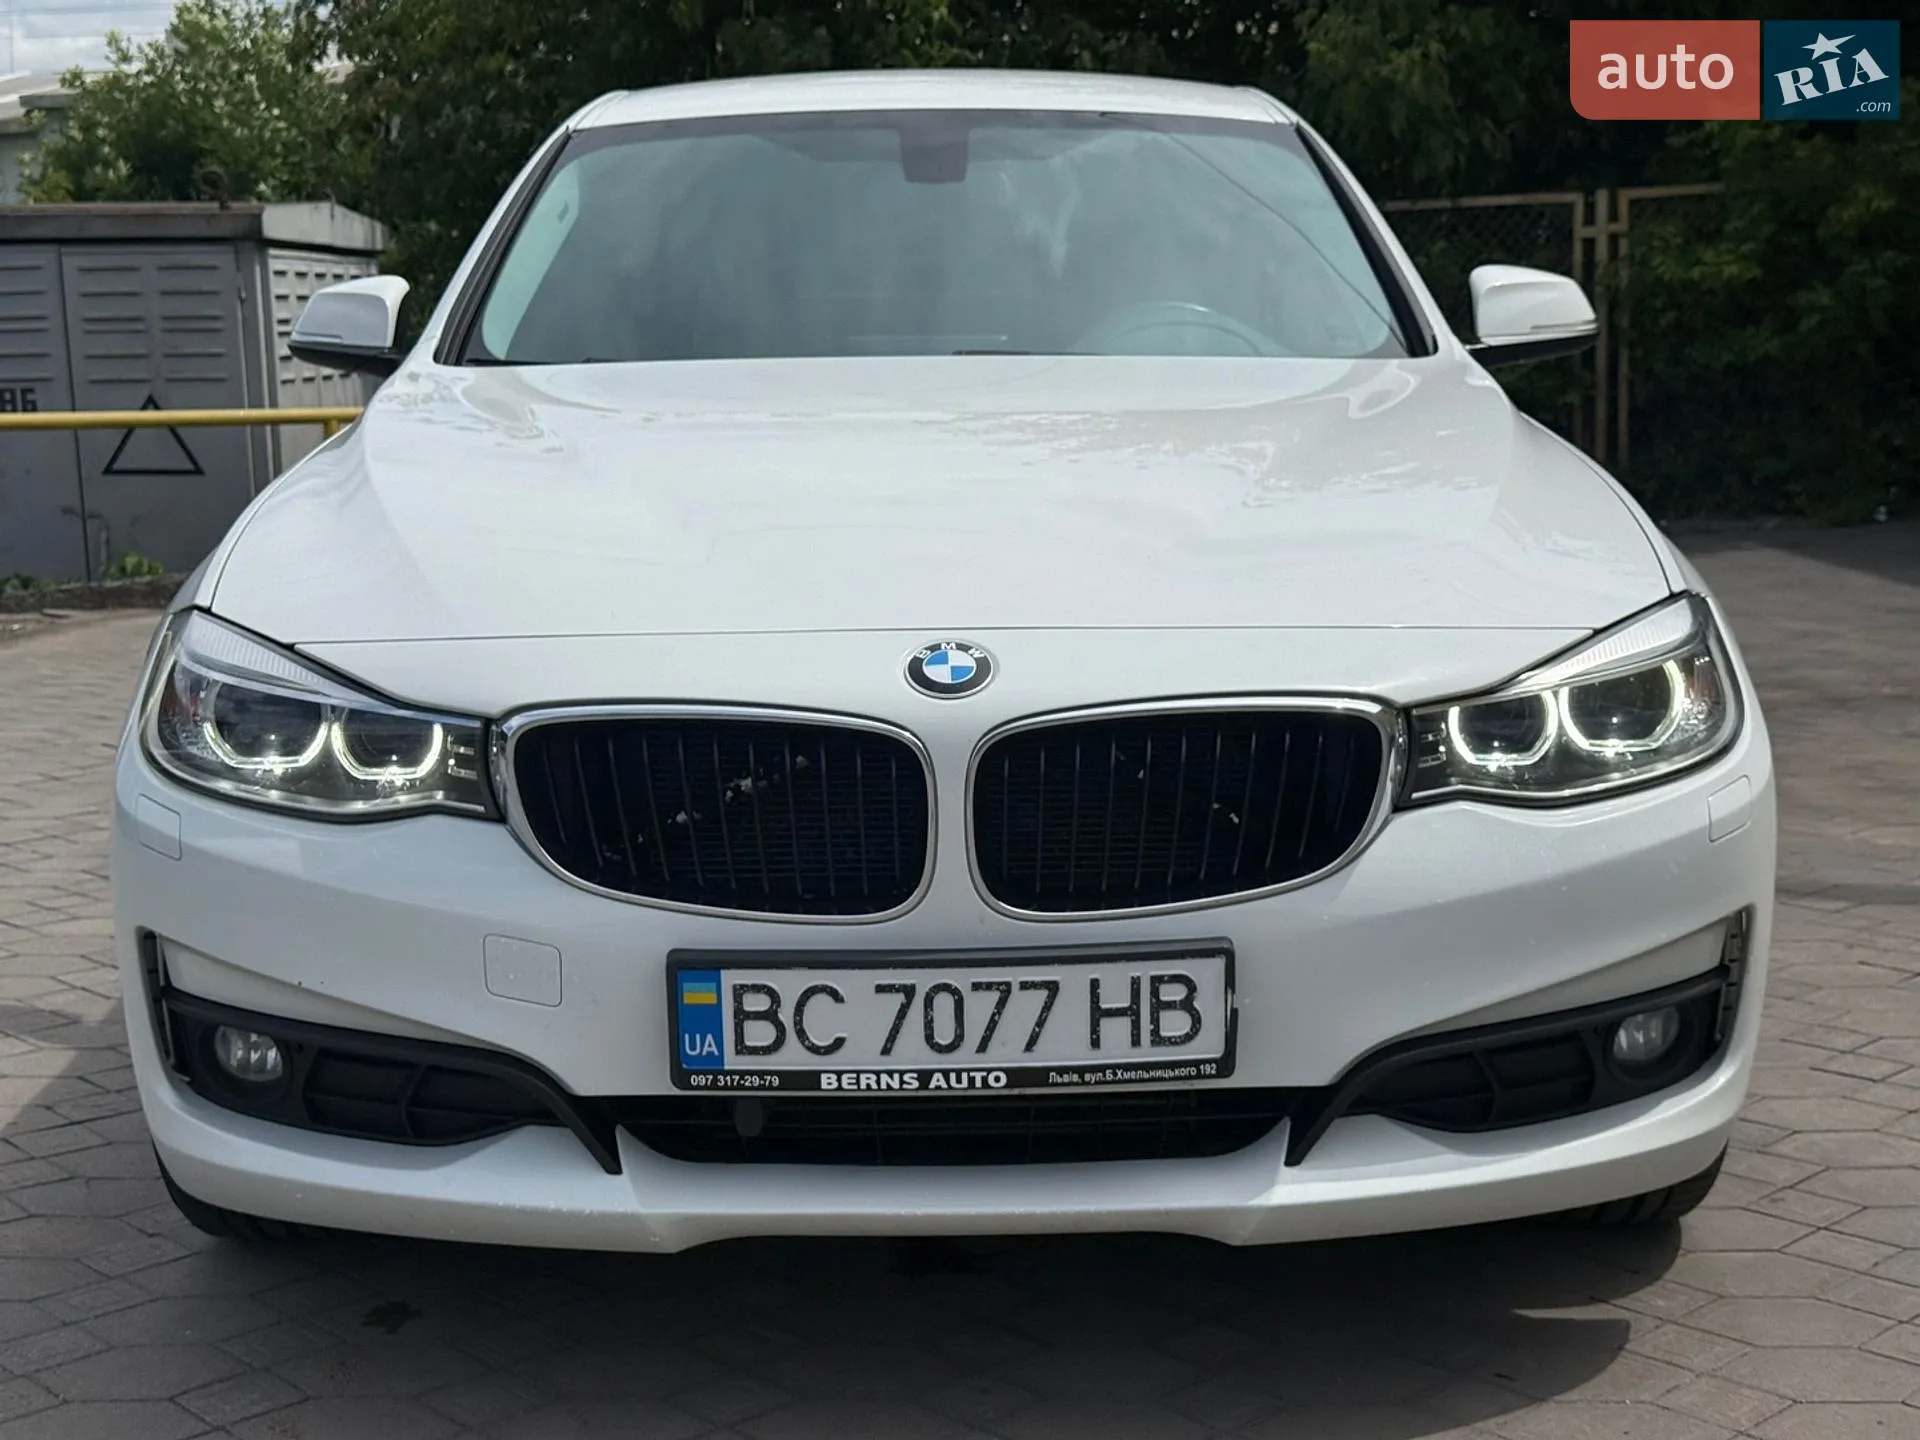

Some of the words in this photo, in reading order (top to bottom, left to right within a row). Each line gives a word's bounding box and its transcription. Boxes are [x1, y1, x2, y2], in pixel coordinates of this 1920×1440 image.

[914, 642, 985, 659] BMW
[732, 983, 848, 1056] BC
[875, 980, 1060, 1056] 7077
[1090, 973, 1202, 1050] HB
[684, 1033, 719, 1056] UA
[1200, 1063, 1217, 1075] 192
[690, 1074, 713, 1087] 097
[717, 1074, 780, 1088] 317-29-79
[820, 1072, 920, 1090] BERNS
[928, 1070, 1008, 1088] AUTO
